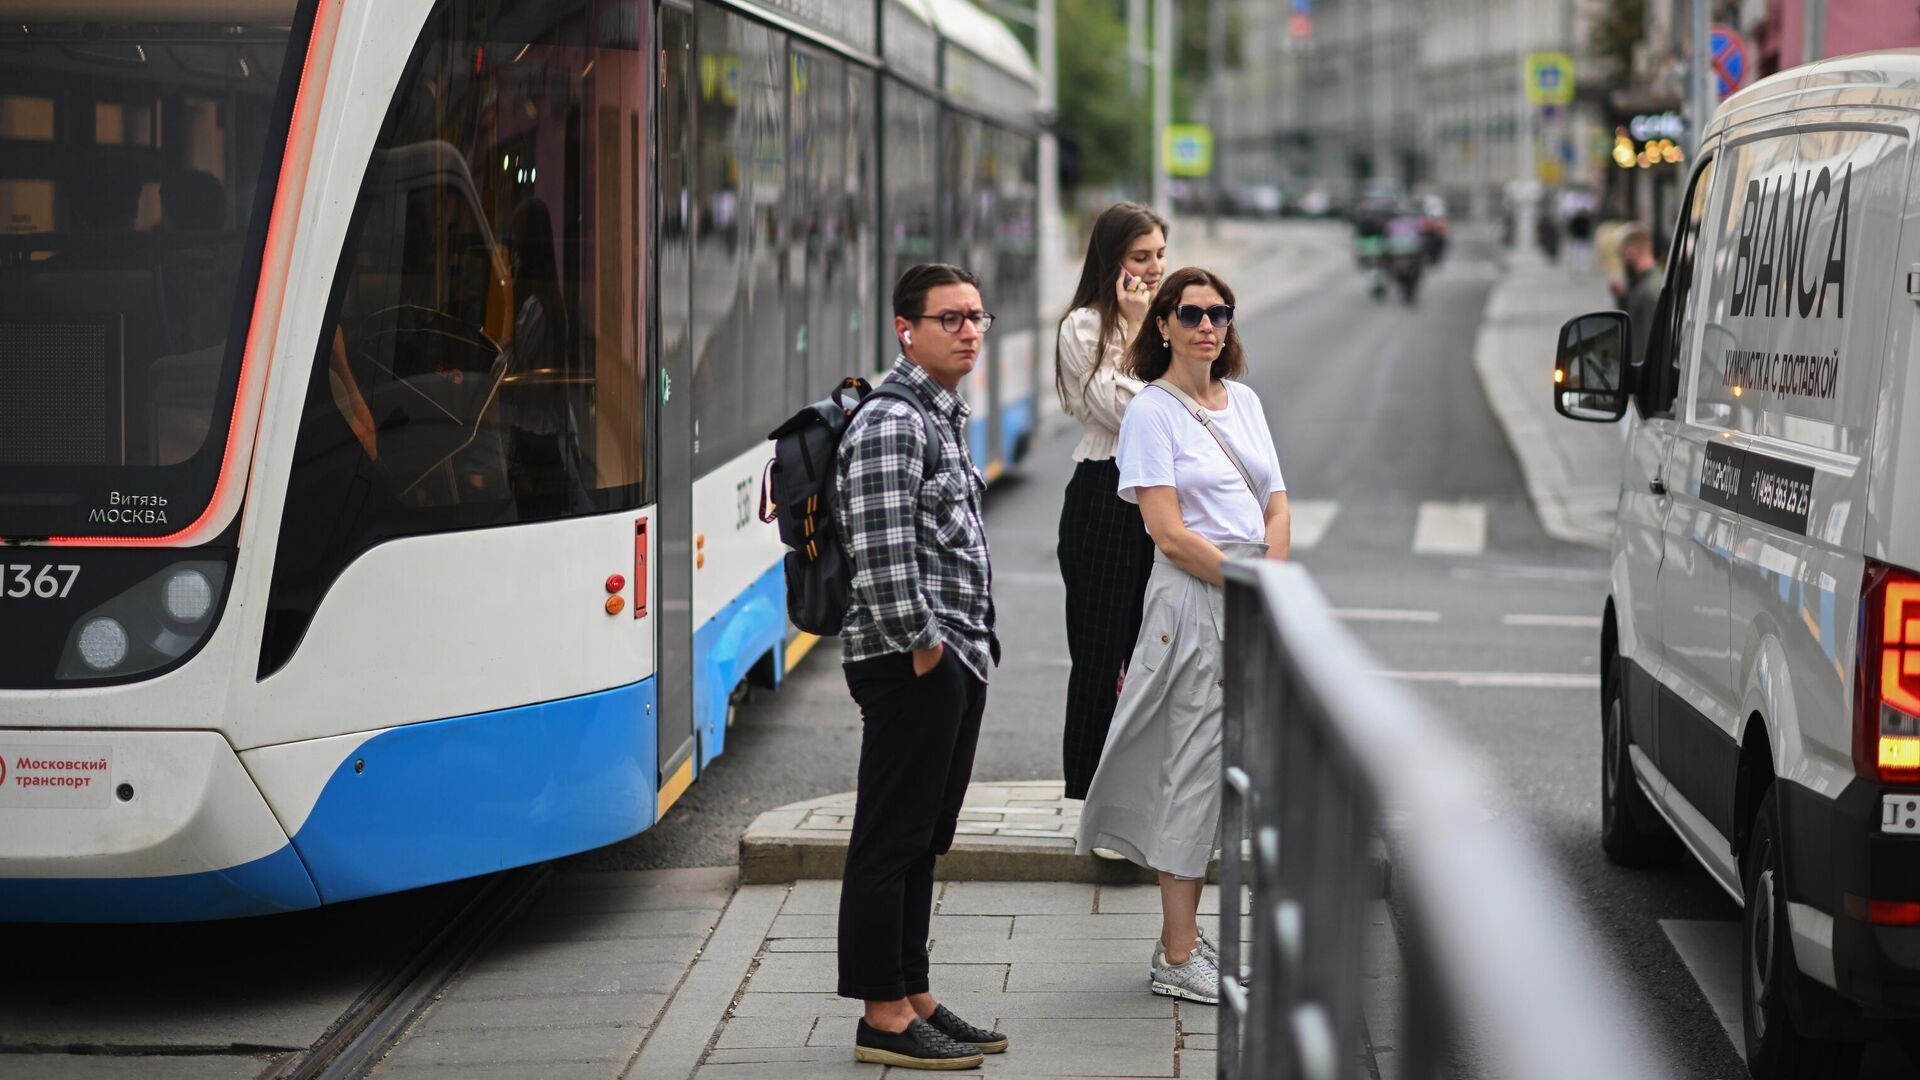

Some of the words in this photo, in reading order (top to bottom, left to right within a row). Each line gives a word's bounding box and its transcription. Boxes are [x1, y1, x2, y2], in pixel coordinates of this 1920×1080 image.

[1729, 162, 1853, 319] BIANCA
[1722, 349, 1771, 391] ХИМЧИСТКА
[1771, 353, 1780, 393] С
[1778, 347, 1839, 400] ДОСТАВКОЙ
[110, 491, 168, 506] Витязь
[1786, 480, 1799, 513] 25
[1796, 483, 1810, 516] 25
[88, 508, 168, 524] МОСКВА
[0, 564, 81, 598] 1367
[16, 756, 107, 770] Московский
[16, 776, 91, 788] транспорт
